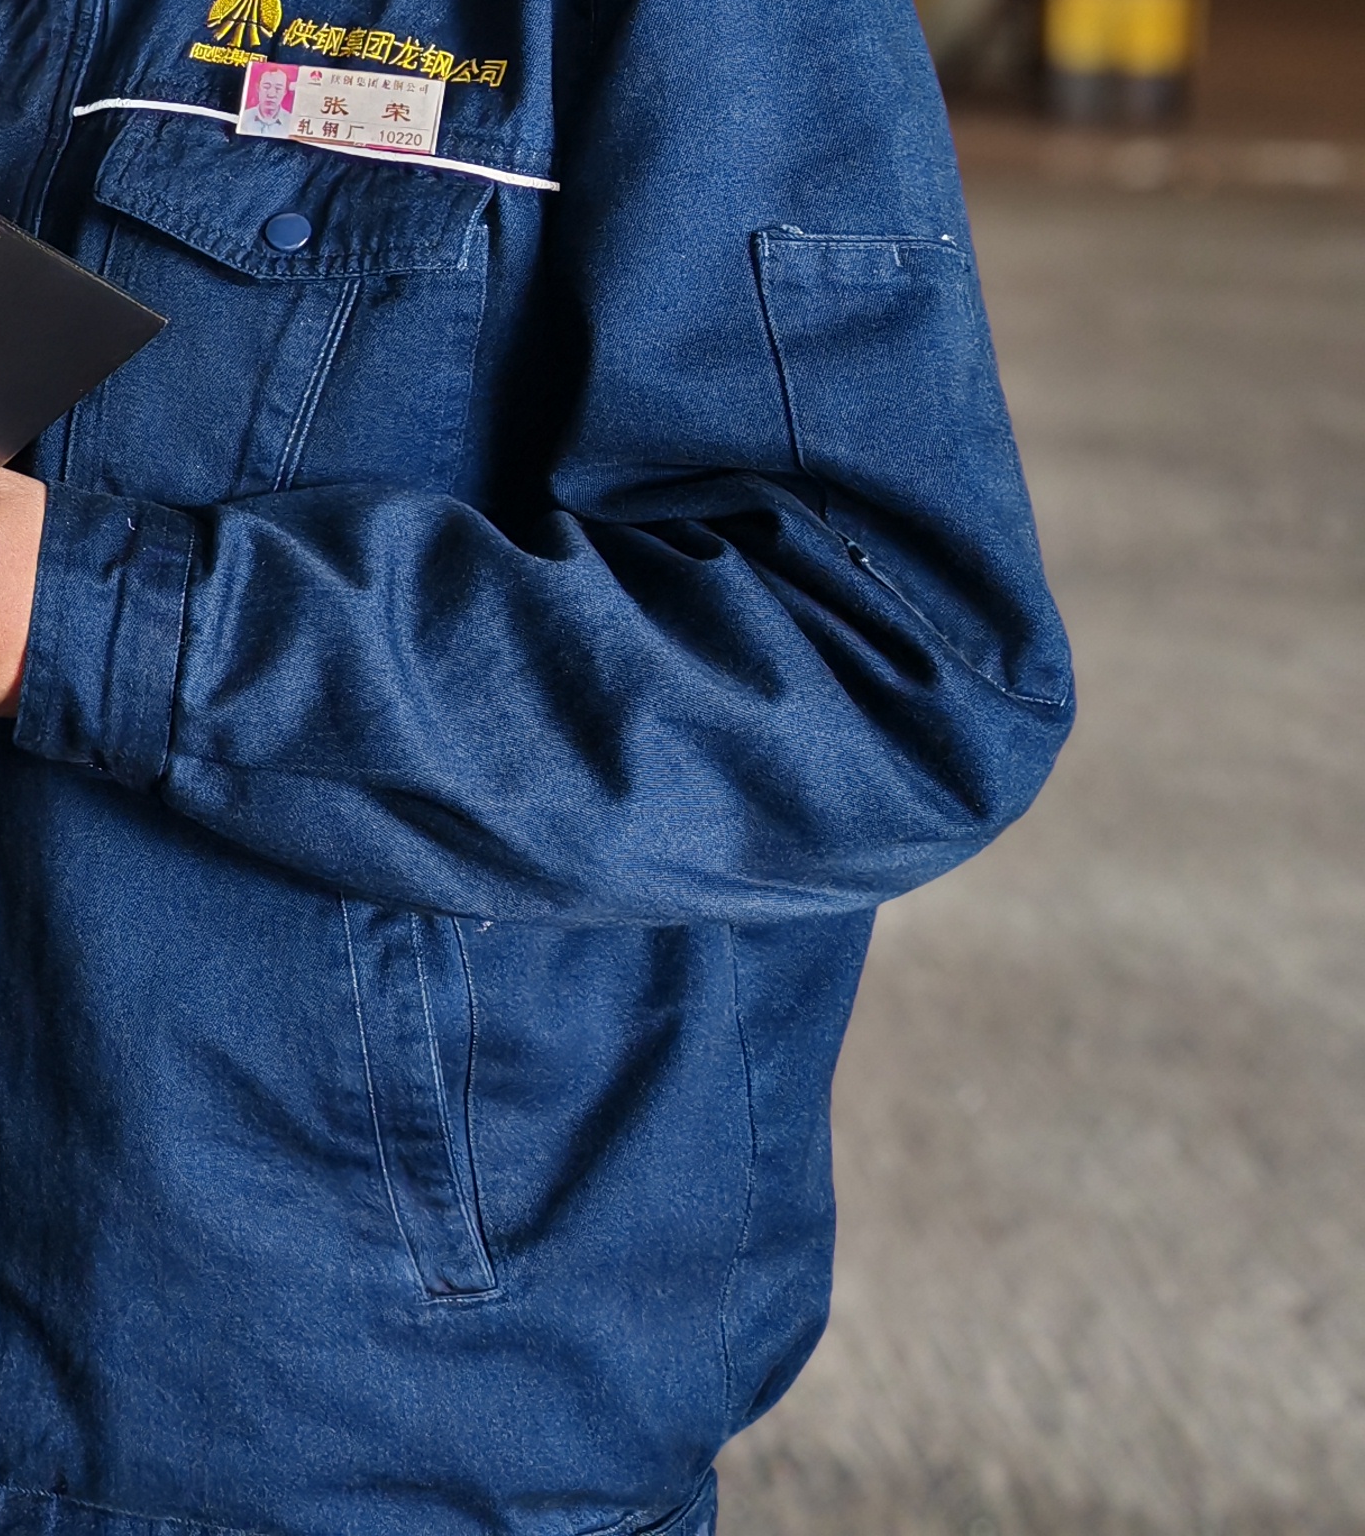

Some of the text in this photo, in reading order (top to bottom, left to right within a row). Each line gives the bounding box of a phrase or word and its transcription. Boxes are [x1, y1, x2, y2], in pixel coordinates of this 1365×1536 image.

[282, 18, 507, 87] 陕钢集团龙钢公司
[296, 118, 365, 139] 轧钢厂
[379, 130, 423, 147] 10220
